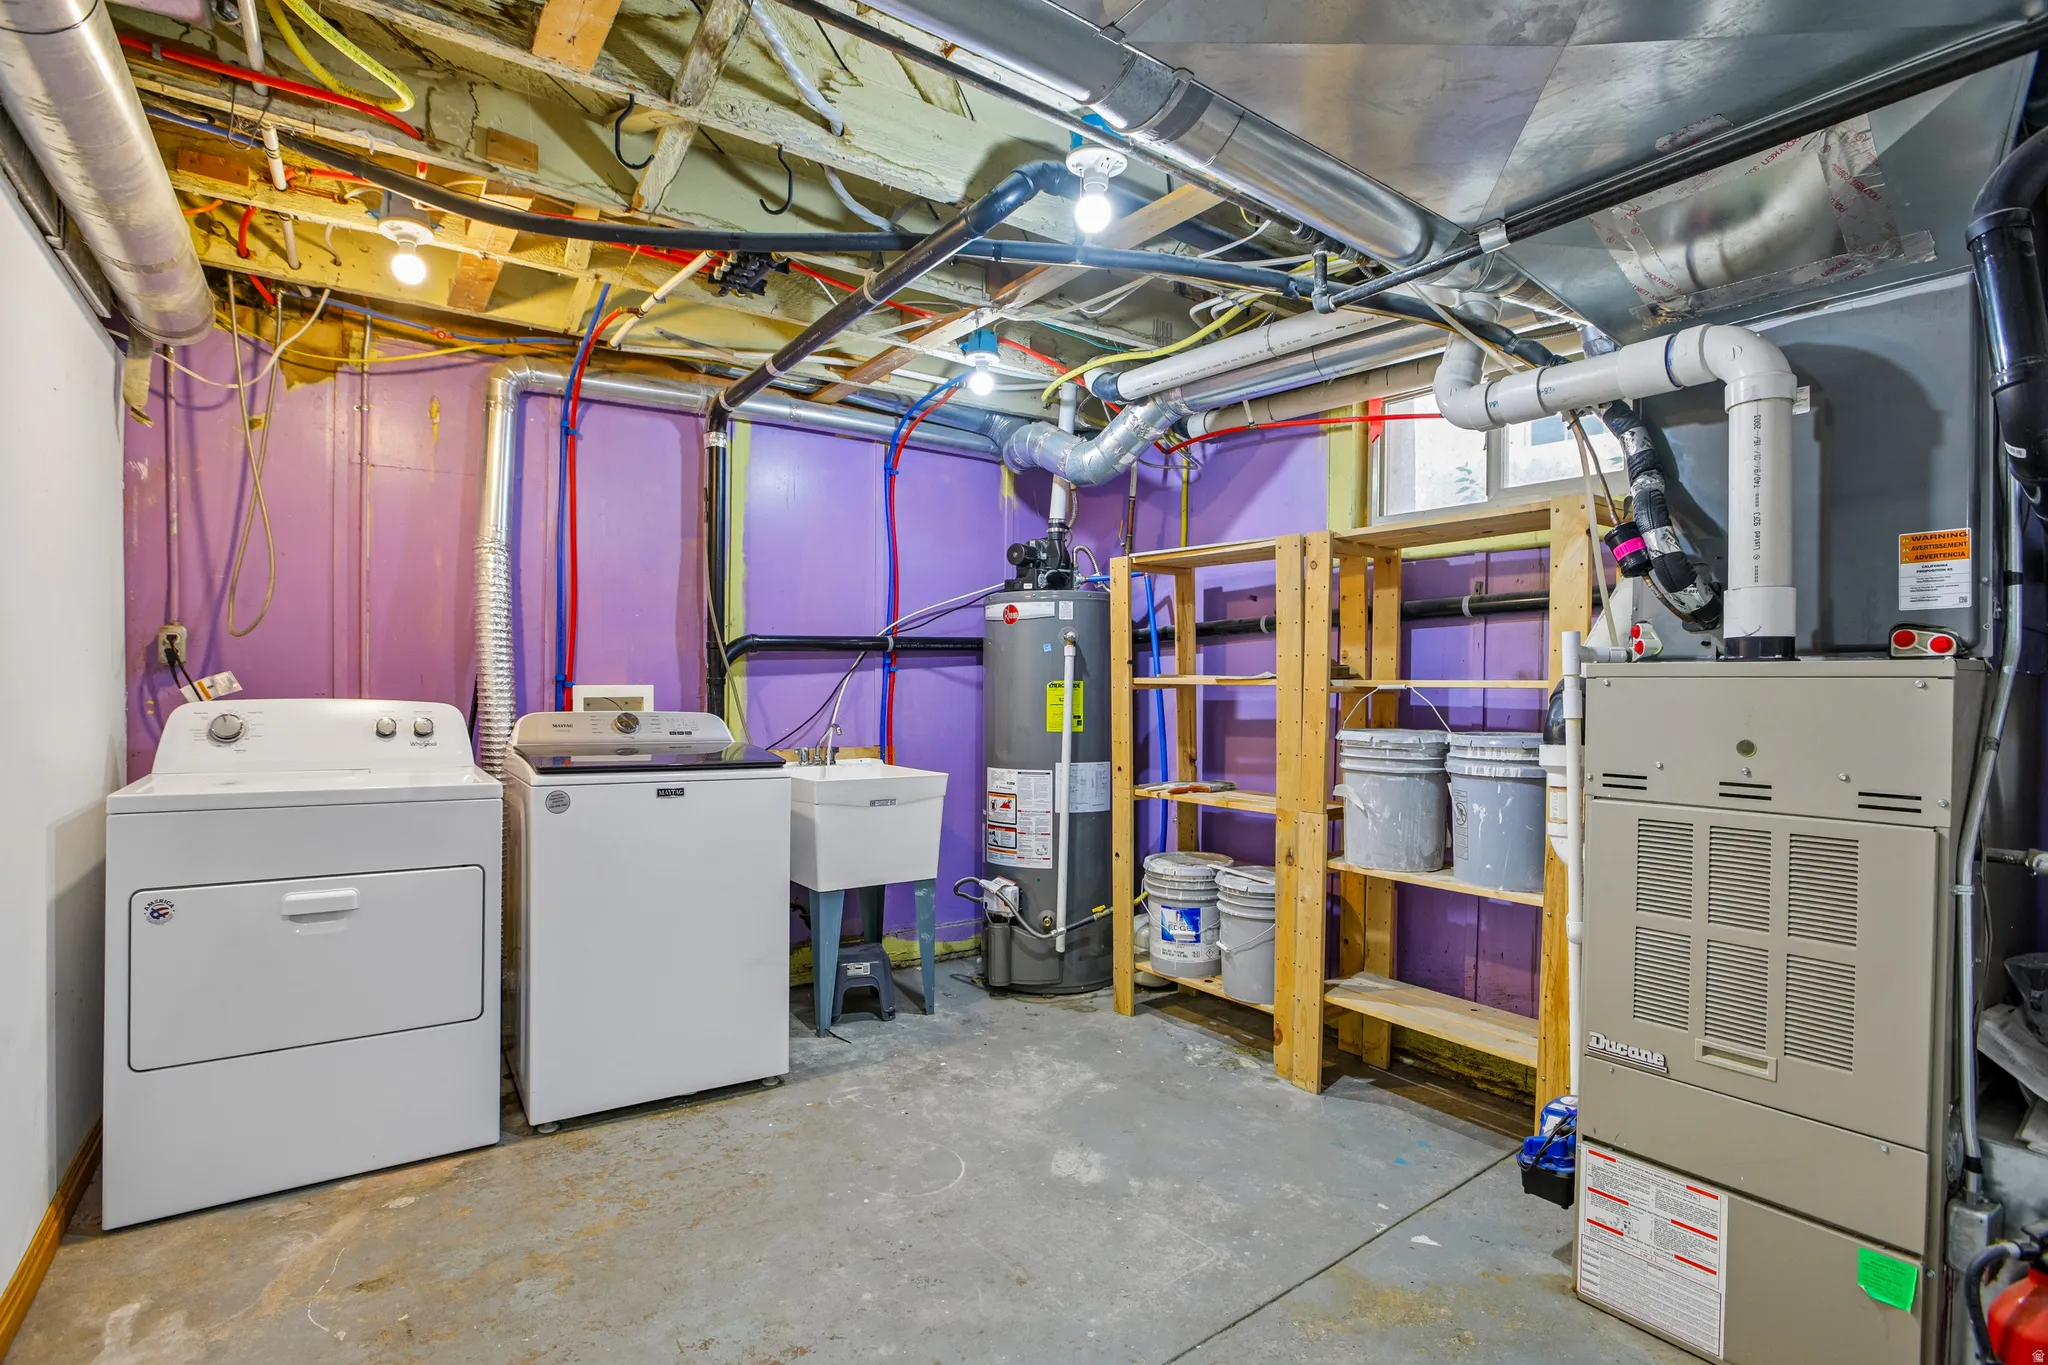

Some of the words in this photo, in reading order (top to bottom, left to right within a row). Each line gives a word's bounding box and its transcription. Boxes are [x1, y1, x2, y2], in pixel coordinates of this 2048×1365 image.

[1753, 530, 1761, 551] Listed
[1911, 531, 1967, 541] WARNING
[1911, 541, 1967, 551] AVERTISSEMENT
[1914, 551, 1966, 561] ADVERTENCIA
[410, 741, 438, 749] Whirlpool
[658, 788, 684, 796] MAYTAG
[144, 898, 175, 911] AMERICA
[1588, 1030, 1667, 1067] Ducane
